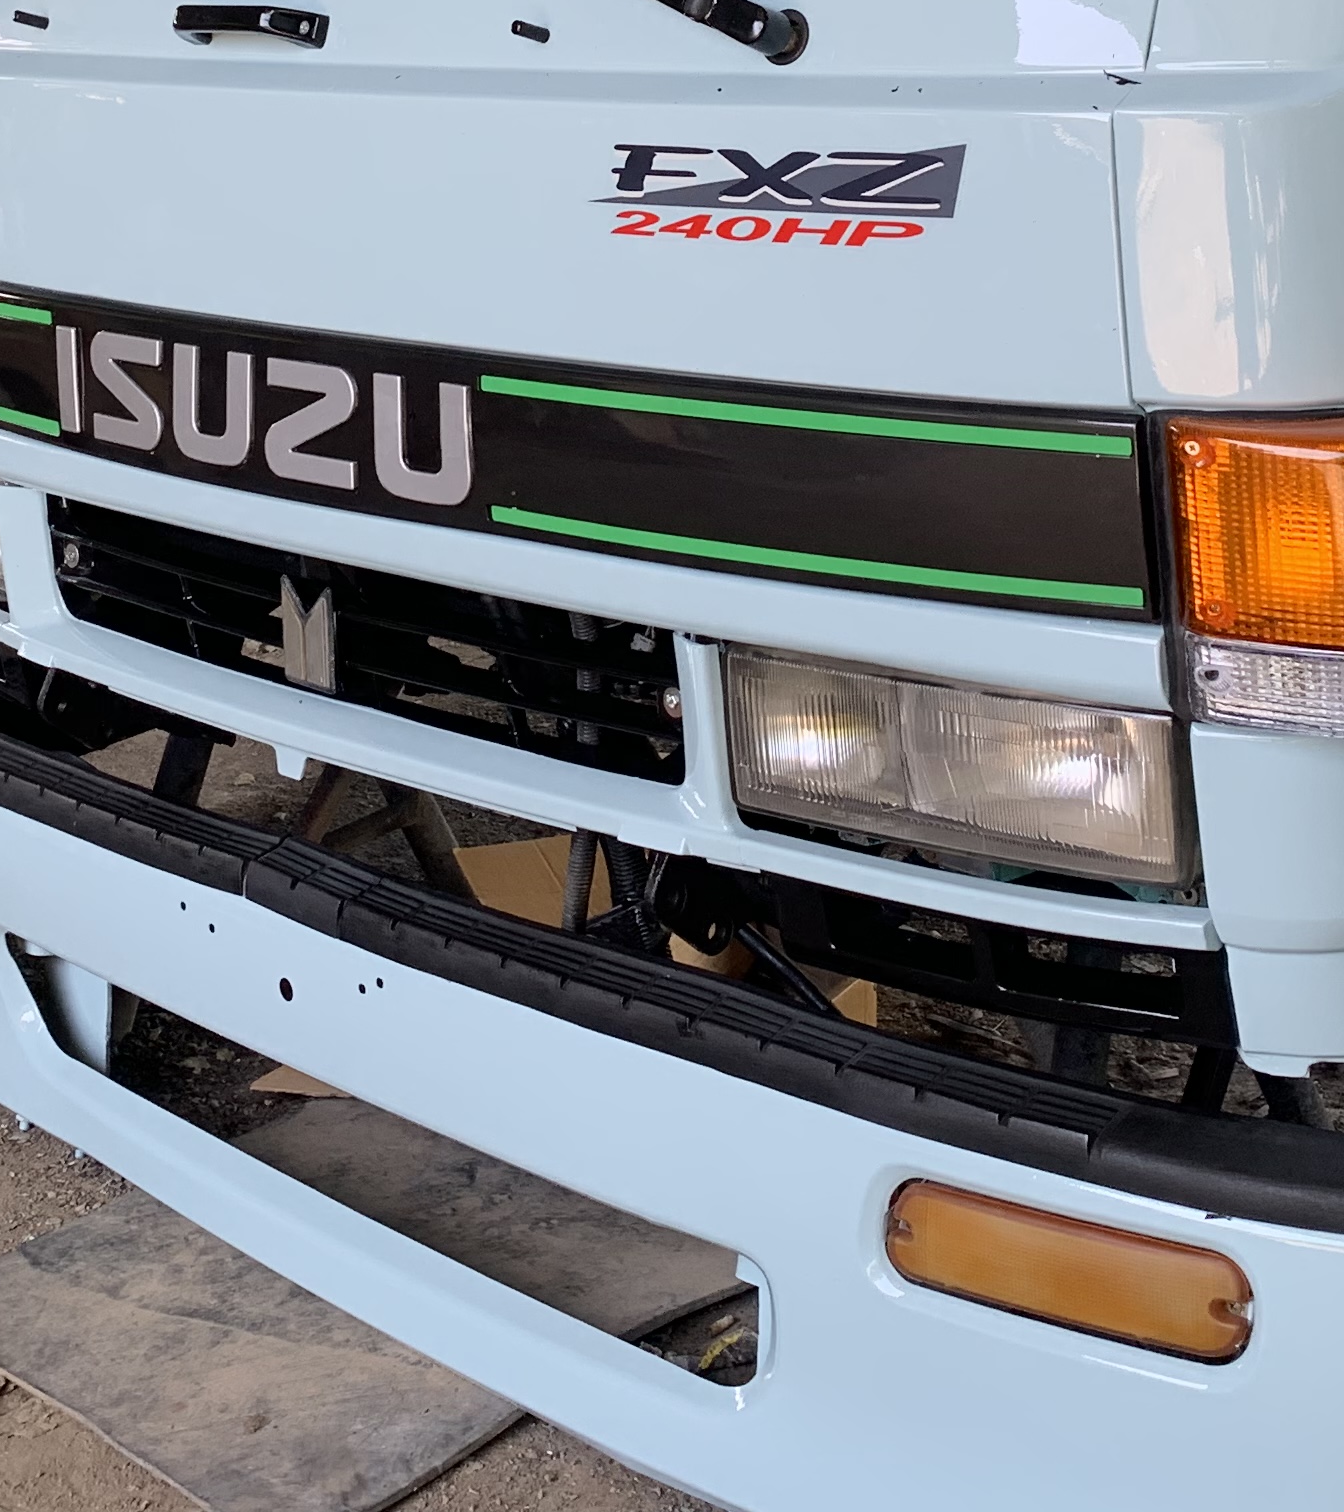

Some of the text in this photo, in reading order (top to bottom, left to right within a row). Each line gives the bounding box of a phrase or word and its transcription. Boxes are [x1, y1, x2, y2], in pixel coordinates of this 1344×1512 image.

[611, 144, 945, 207] FXZ
[610, 210, 925, 247] 240HP
[55, 324, 473, 507] ISUZU
